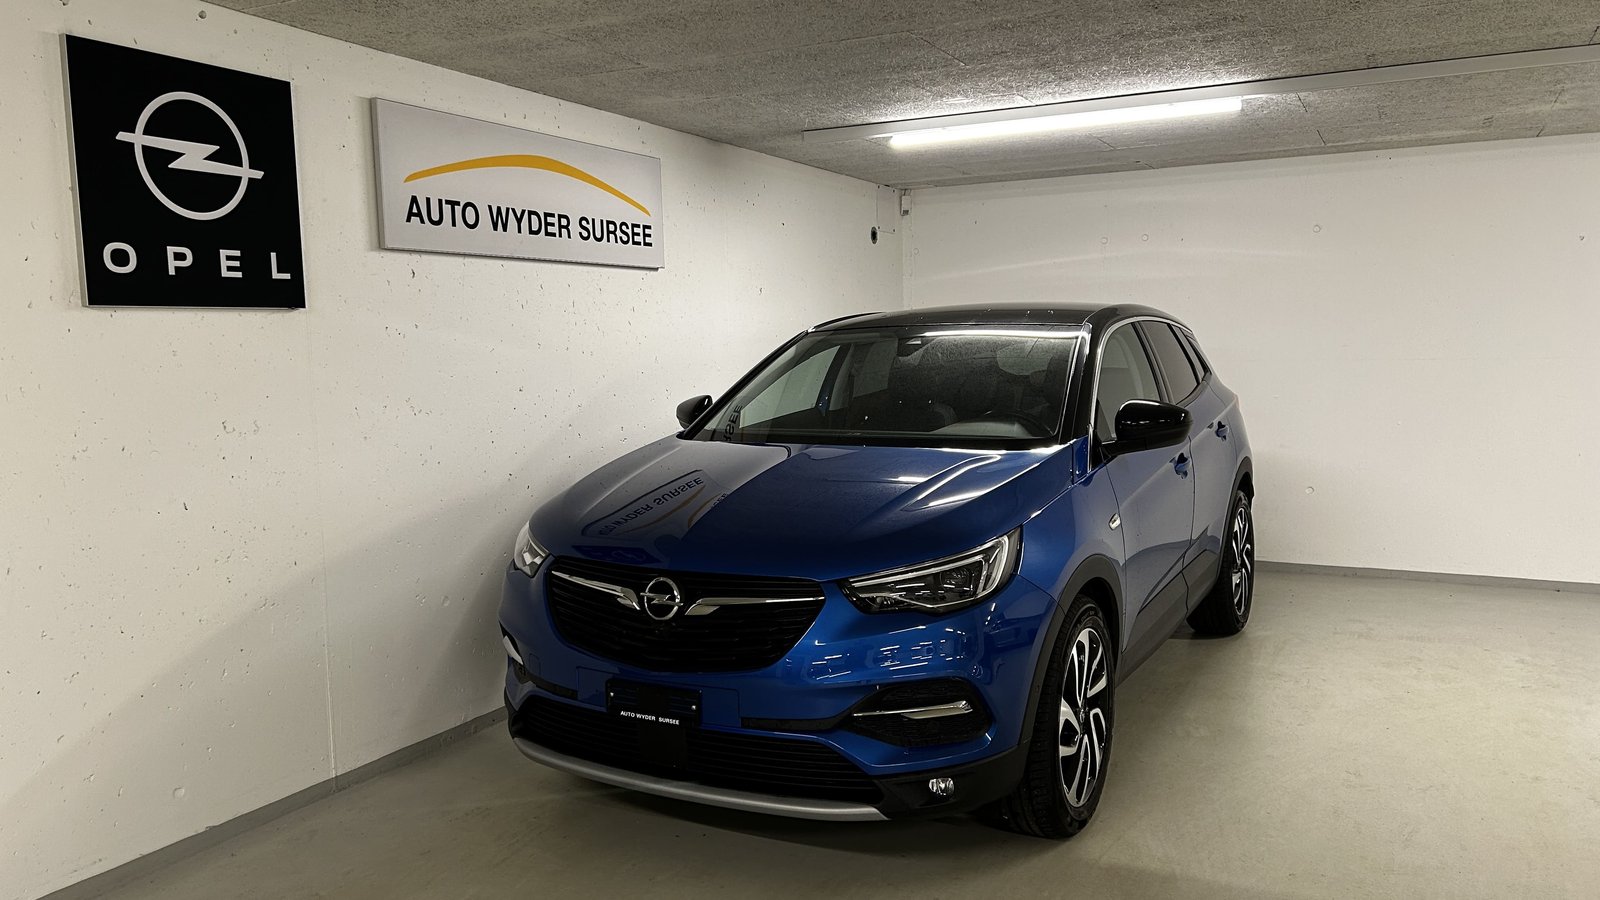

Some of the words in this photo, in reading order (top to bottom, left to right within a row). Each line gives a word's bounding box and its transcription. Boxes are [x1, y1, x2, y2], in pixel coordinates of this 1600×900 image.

[405, 194, 479, 230] AUTO
[488, 204, 572, 240] WYDER
[579, 216, 653, 248] SURSEE
[103, 241, 291, 280] OPEL
[620, 710, 635, 718] AUTO
[636, 712, 656, 721] WYDER
[659, 716, 680, 726] SURSEE
